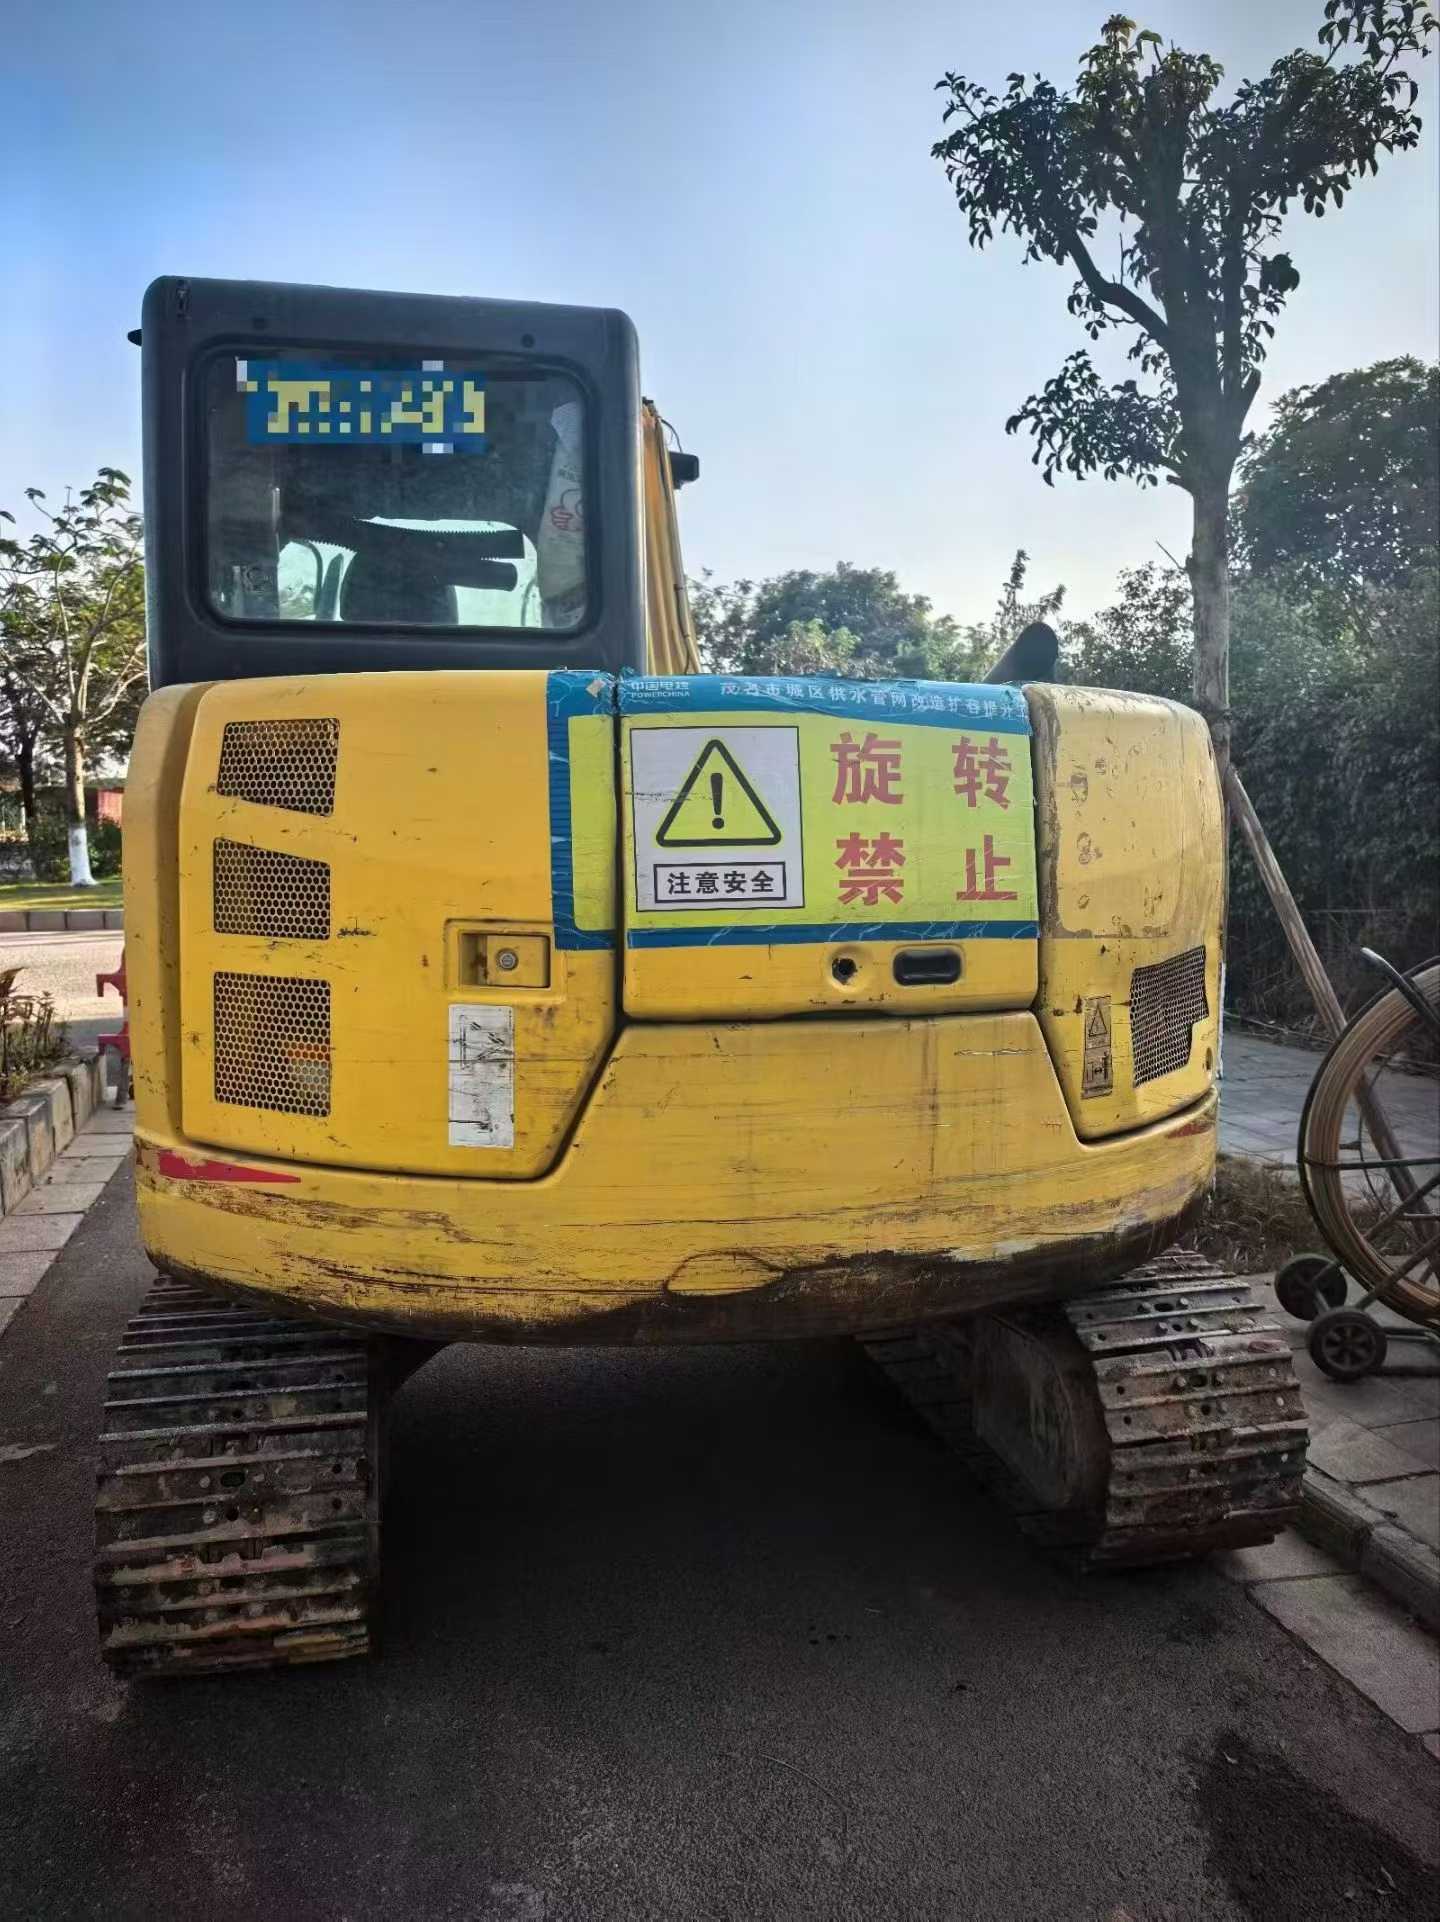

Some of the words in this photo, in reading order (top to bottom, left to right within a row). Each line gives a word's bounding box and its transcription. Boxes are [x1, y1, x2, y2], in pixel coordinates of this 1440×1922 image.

[830, 732, 1013, 810] 旋转
[667, 870, 775, 896] 注意安全
[835, 831, 1018, 906] 禁止
